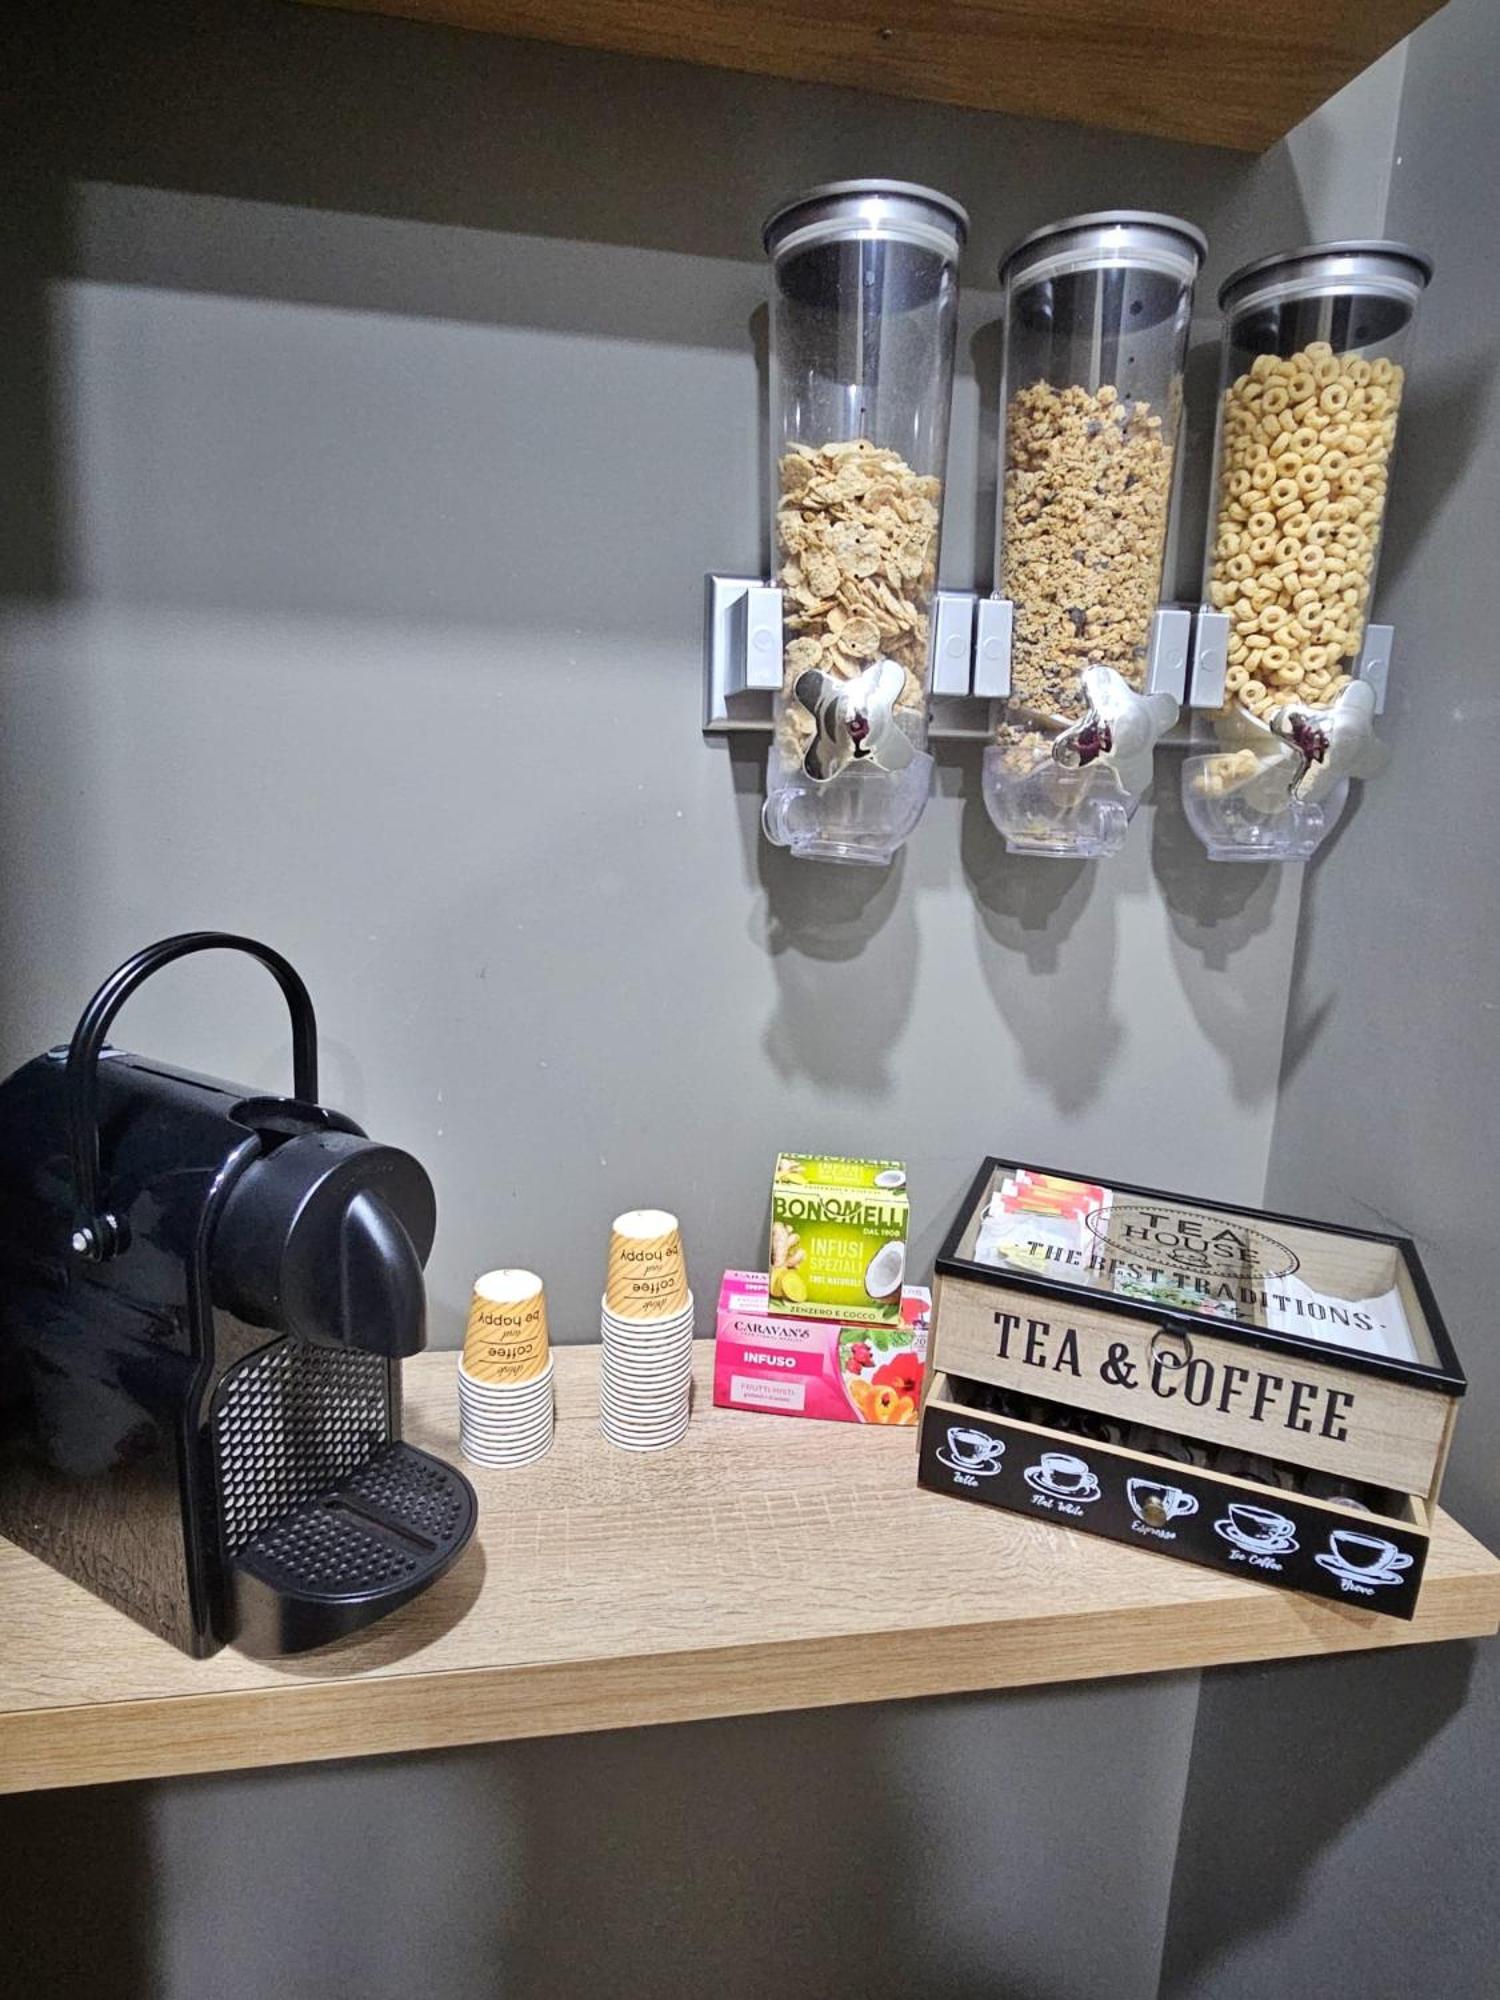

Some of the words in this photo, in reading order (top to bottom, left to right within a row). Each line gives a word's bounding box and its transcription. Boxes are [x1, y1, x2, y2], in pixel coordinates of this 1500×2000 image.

[773, 1196, 908, 1226] BONOMELLI
[1139, 1211, 1247, 1247] TEA
[811, 1237, 864, 1259] INFUSI
[1125, 1223, 1260, 1265] HOUSE
[620, 1249, 662, 1262] happy
[1027, 1240, 1082, 1266] THE
[1090, 1255, 1164, 1284] BEST
[810, 1257, 863, 1274] SPEZIALI
[632, 1279, 674, 1294] coffee
[478, 1312, 521, 1328] happy
[525, 1310, 540, 1323] be
[790, 1305, 832, 1316] ZENZERO
[835, 1309, 840, 1317] E
[843, 1310, 876, 1320] COCCO
[488, 1343, 533, 1360] coffee
[743, 1351, 796, 1368] INFUSO
[994, 1312, 1081, 1377] TEA
[1099, 1342, 1139, 1390] &
[1151, 1350, 1355, 1442] COFFEE
[1248, 1554, 1284, 1571] Coffee
